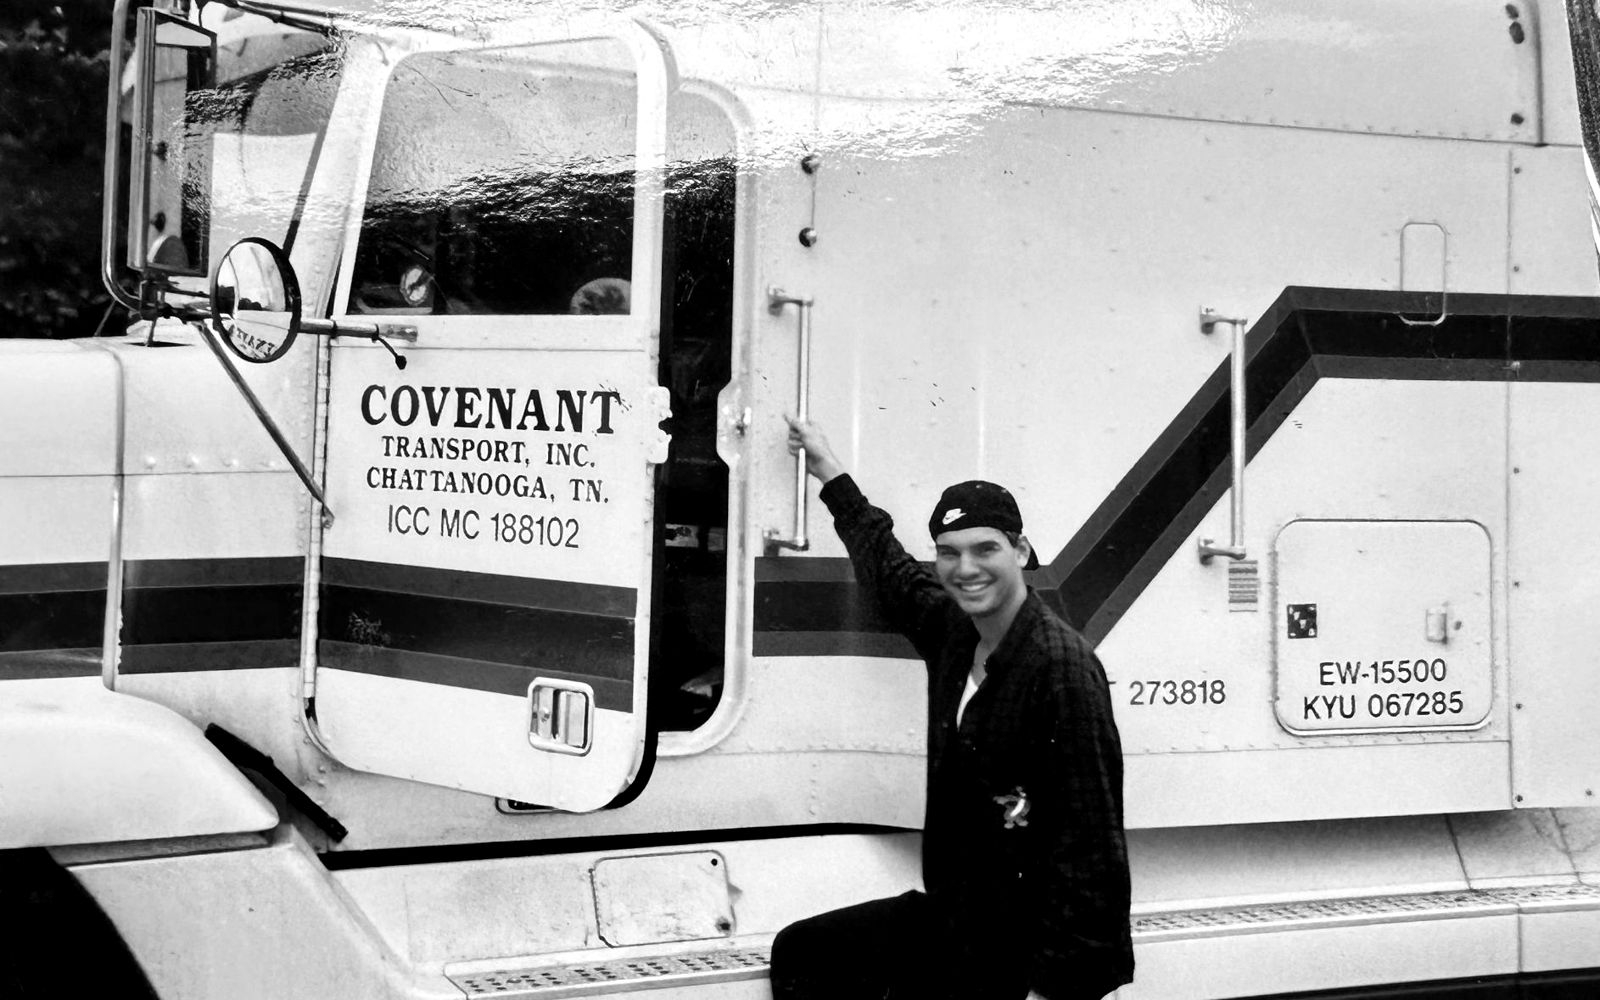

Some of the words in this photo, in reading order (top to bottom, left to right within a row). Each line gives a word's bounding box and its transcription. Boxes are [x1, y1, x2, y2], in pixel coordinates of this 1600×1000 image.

[360, 384, 623, 435] COVENANT
[381, 435, 530, 468] TRANSPORT,
[545, 442, 595, 468] INC.
[366, 466, 555, 503] CHATTANOOGA,
[569, 478, 609, 504] TN.
[388, 504, 430, 536] ICC
[440, 508, 480, 540] MC
[490, 511, 579, 549] 188102
[1319, 658, 1447, 686] EW-15500
[1129, 679, 1226, 706] 273818
[1303, 694, 1356, 720] KYU
[1367, 690, 1464, 718] 067285
